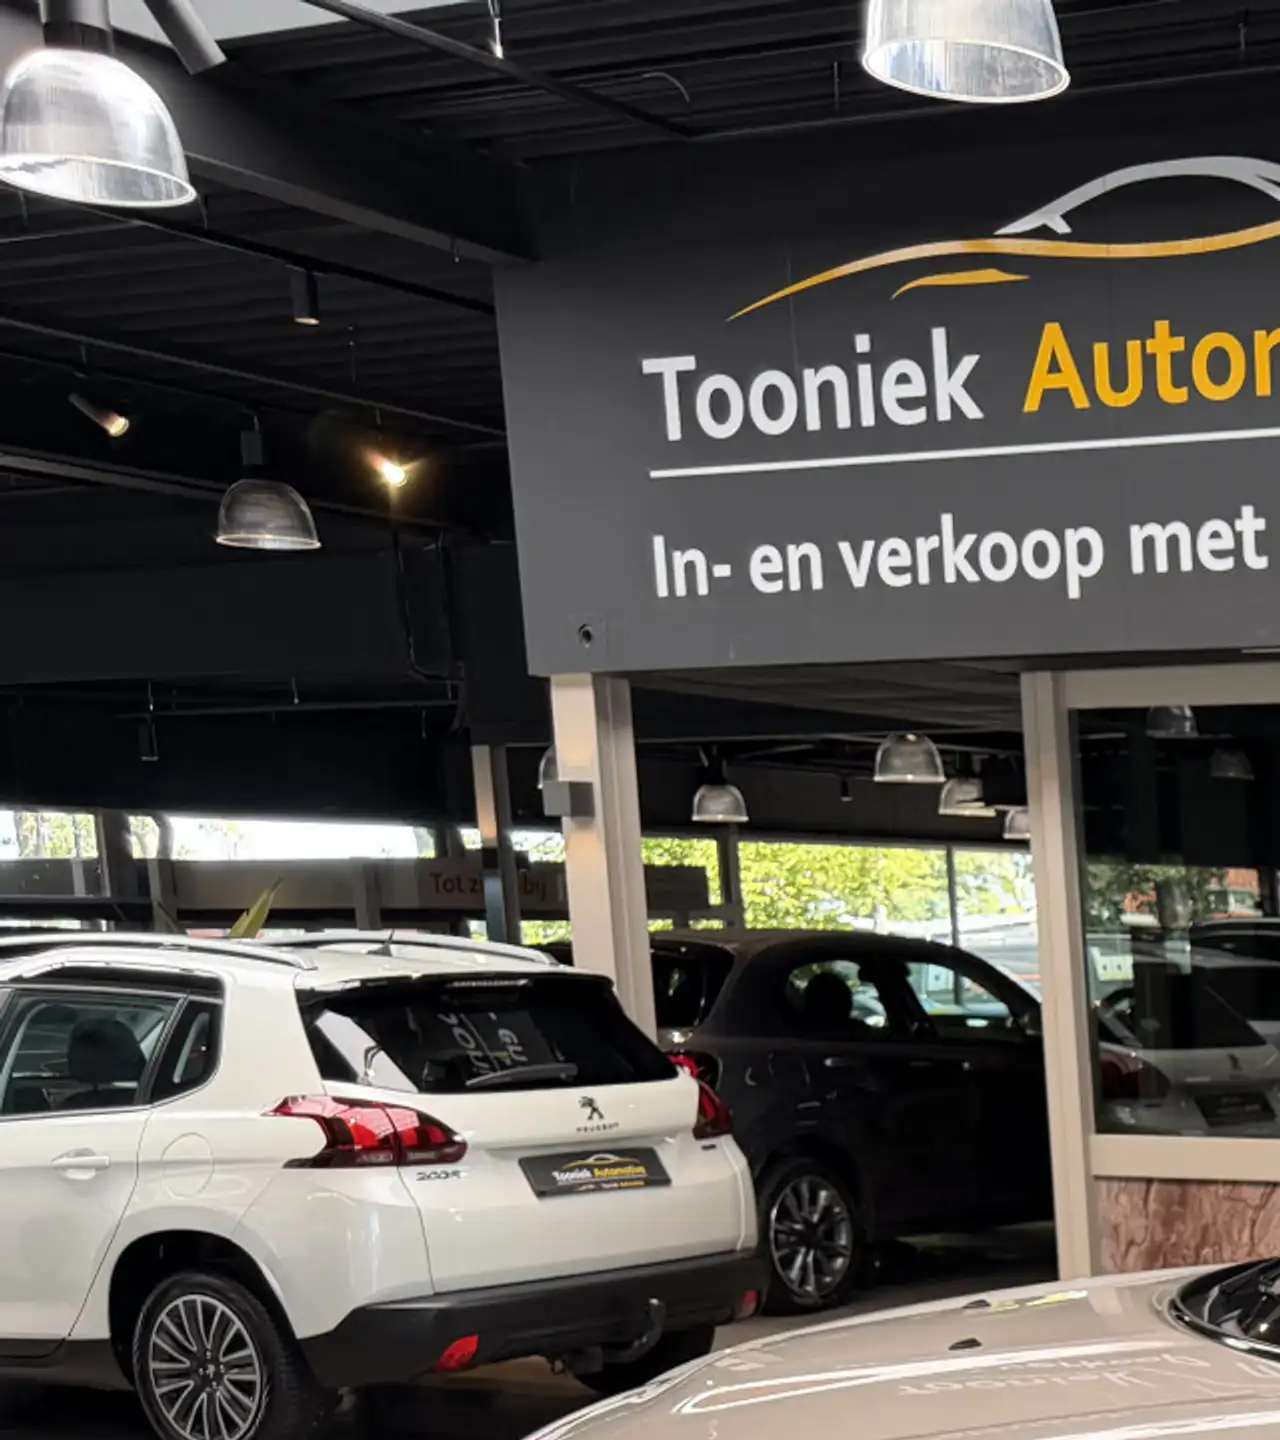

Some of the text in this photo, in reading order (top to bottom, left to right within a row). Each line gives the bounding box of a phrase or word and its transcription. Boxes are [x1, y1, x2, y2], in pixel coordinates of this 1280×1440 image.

[642, 327, 984, 441] Tooniek
[653, 535, 732, 597] In-
[749, 541, 824, 593] en
[837, 512, 1104, 599] verkoop
[1129, 504, 1268, 575] met
